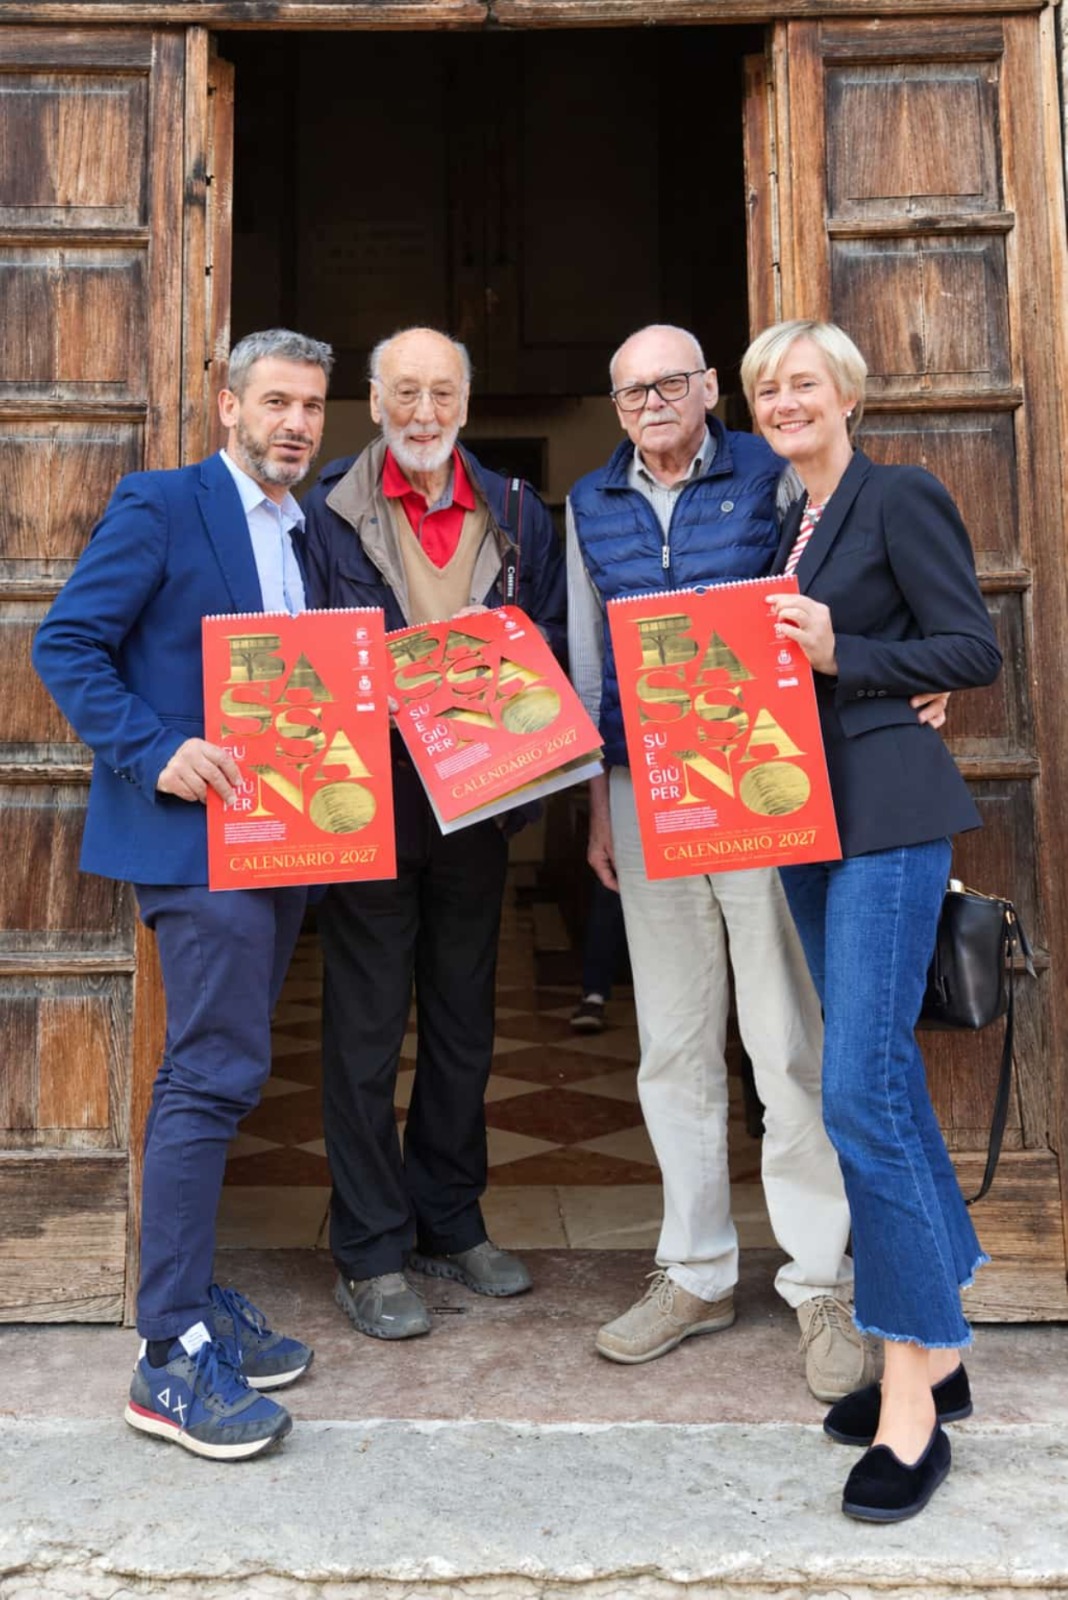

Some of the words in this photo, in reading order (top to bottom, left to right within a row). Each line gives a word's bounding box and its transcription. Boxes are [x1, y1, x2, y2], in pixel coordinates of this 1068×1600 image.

[408, 702, 430, 720] SU
[415, 720, 427, 733] E
[421, 723, 448, 744] GIÙ
[426, 737, 454, 757] PER
[643, 732, 668, 748] SU
[451, 748, 543, 799] CALENDARIO
[546, 728, 578, 753] 2027
[645, 751, 658, 766] E
[649, 764, 680, 784] GIÙ
[651, 785, 681, 801] PER
[663, 835, 773, 861] CALENDARIO
[778, 829, 817, 848] 2027
[229, 850, 335, 871] CALENDARIO
[340, 847, 378, 865] 2027
